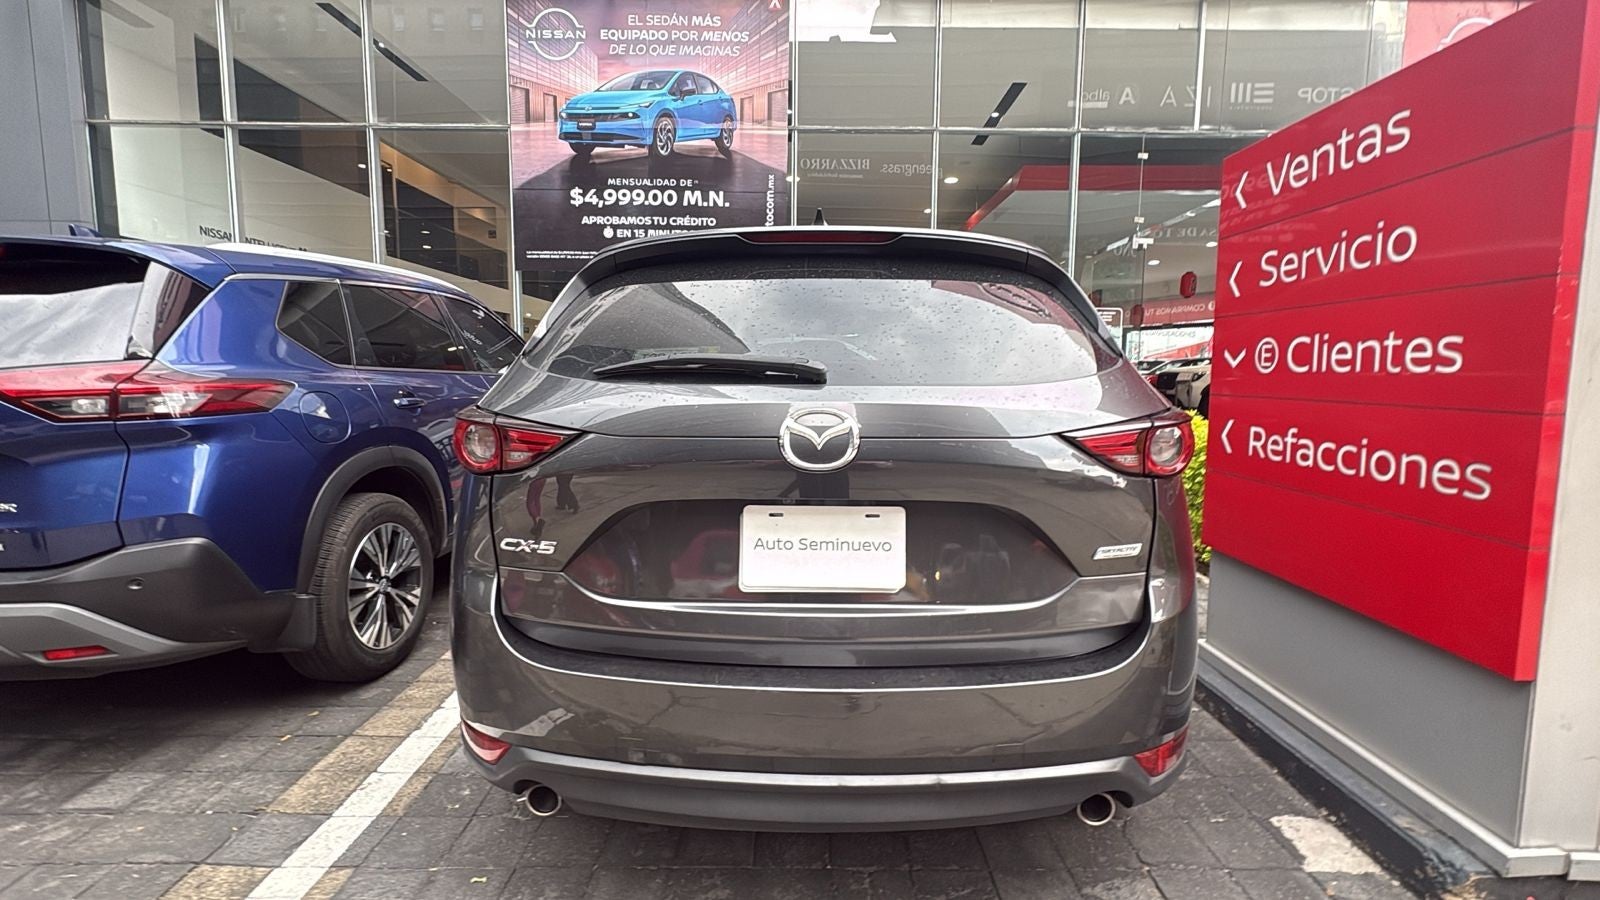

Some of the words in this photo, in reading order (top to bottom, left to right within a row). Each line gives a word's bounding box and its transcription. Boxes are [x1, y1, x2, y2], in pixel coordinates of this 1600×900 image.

[628, 15, 642, 26] EL
[646, 12, 688, 26] SEDÁN
[691, 13, 721, 27] MÁS
[526, 28, 586, 39] NISSAN
[600, 30, 668, 41] EQUIPADO
[672, 31, 698, 41] POR
[701, 32, 749, 42] MENOS
[609, 44, 626, 55] DE
[629, 45, 646, 55] LO
[649, 45, 676, 57] QUE
[679, 46, 740, 56] IMAGINAS
[1265, 108, 1412, 197] Ventas
[608, 178, 676, 187] MENSUALIDAD
[680, 179, 693, 187] DE
[569, 187, 678, 208] $4,999.00
[683, 189, 730, 208] M.N.
[765, 174, 774, 226] tocom.mx
[581, 215, 651, 226] APROBAMOS
[652, 217, 667, 226] TU
[669, 214, 716, 227] CRÉDITO
[616, 228, 631, 238] EN
[634, 229, 645, 238] 15
[1258, 220, 1418, 288] Servicio
[1286, 330, 1465, 374] Clientes
[1248, 425, 1493, 501] Refacciones
[500, 537, 557, 555] CX-5
[753, 537, 794, 551] Auto
[798, 538, 892, 552] Seminuevo
